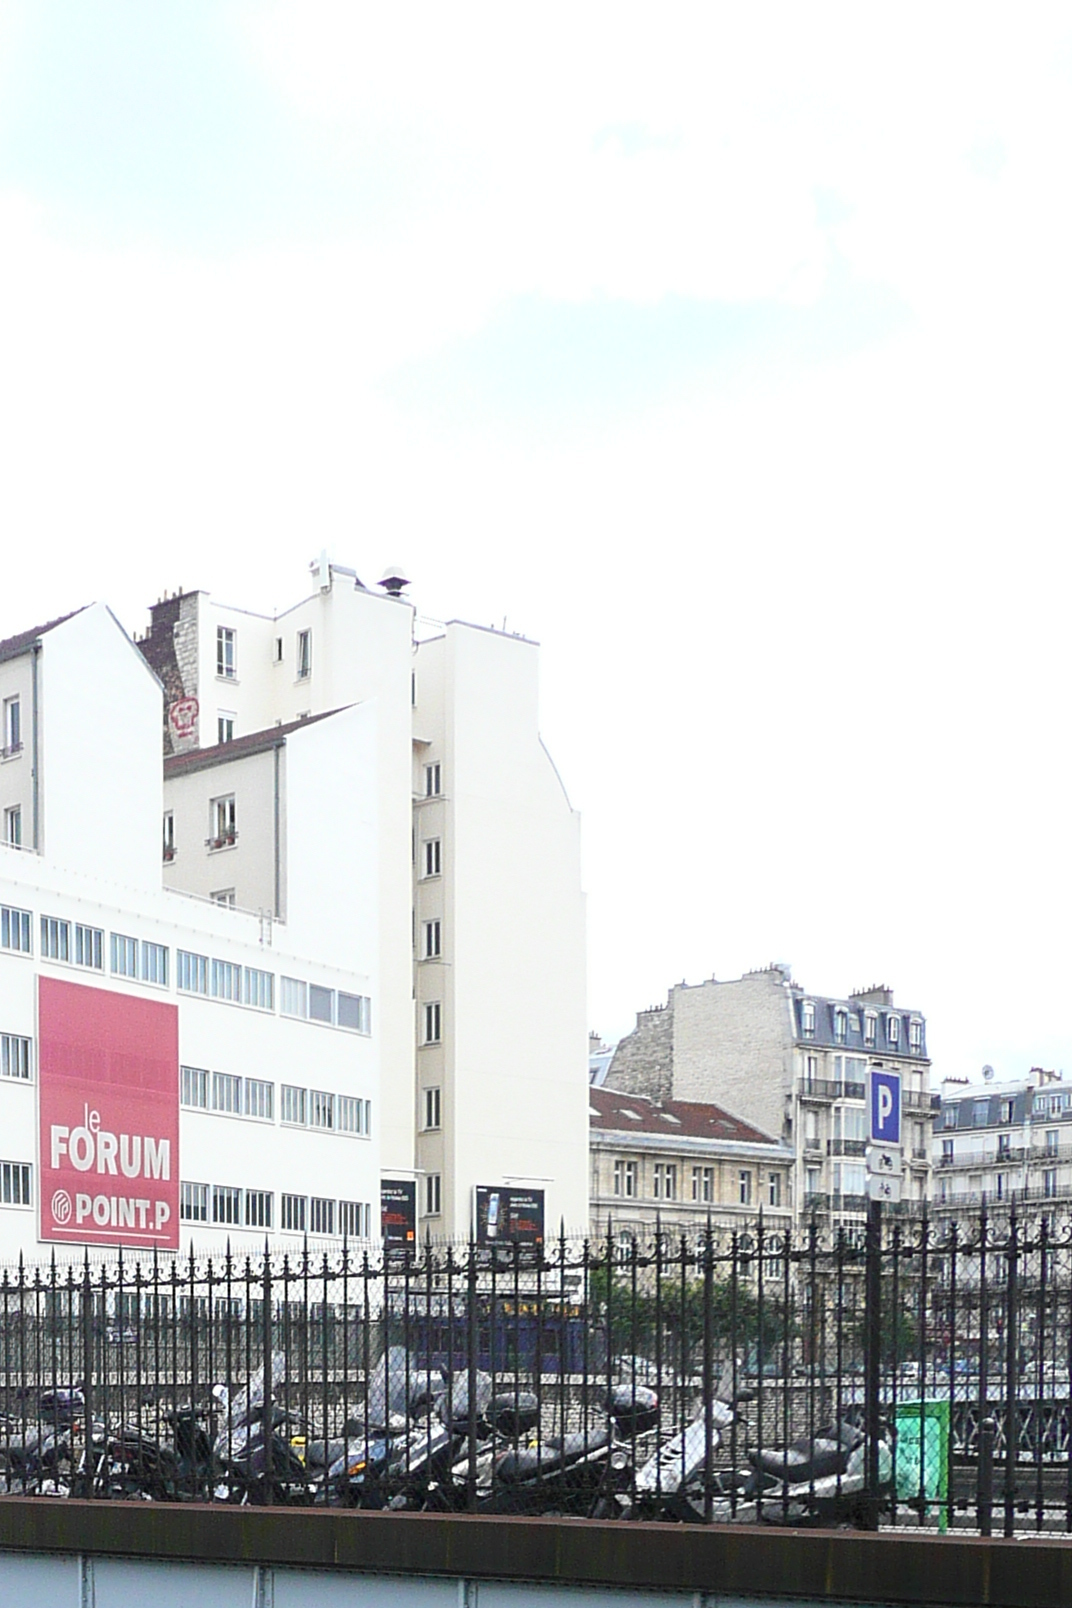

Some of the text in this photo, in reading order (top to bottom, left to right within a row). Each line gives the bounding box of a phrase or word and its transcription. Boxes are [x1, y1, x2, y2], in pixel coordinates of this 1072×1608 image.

[85, 1102, 101, 1133] le
[878, 1084, 893, 1130] P
[50, 1124, 171, 1181] FORUM
[76, 1193, 171, 1231] POINT.P
